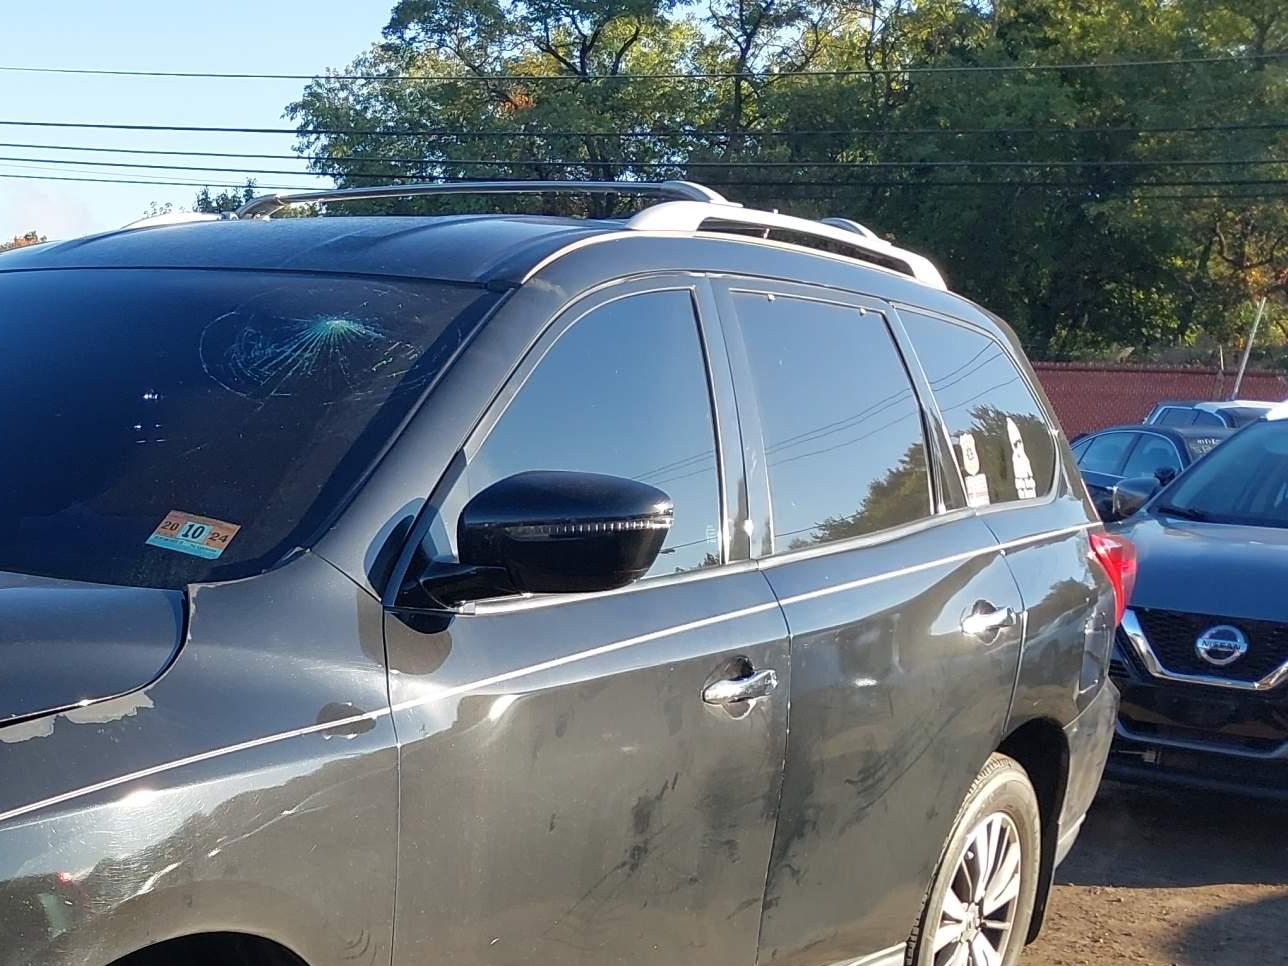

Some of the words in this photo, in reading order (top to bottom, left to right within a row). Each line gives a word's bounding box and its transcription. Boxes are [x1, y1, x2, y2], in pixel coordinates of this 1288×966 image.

[161, 521, 179, 531] 20
[181, 524, 205, 539] 10
[208, 532, 228, 543] 24
